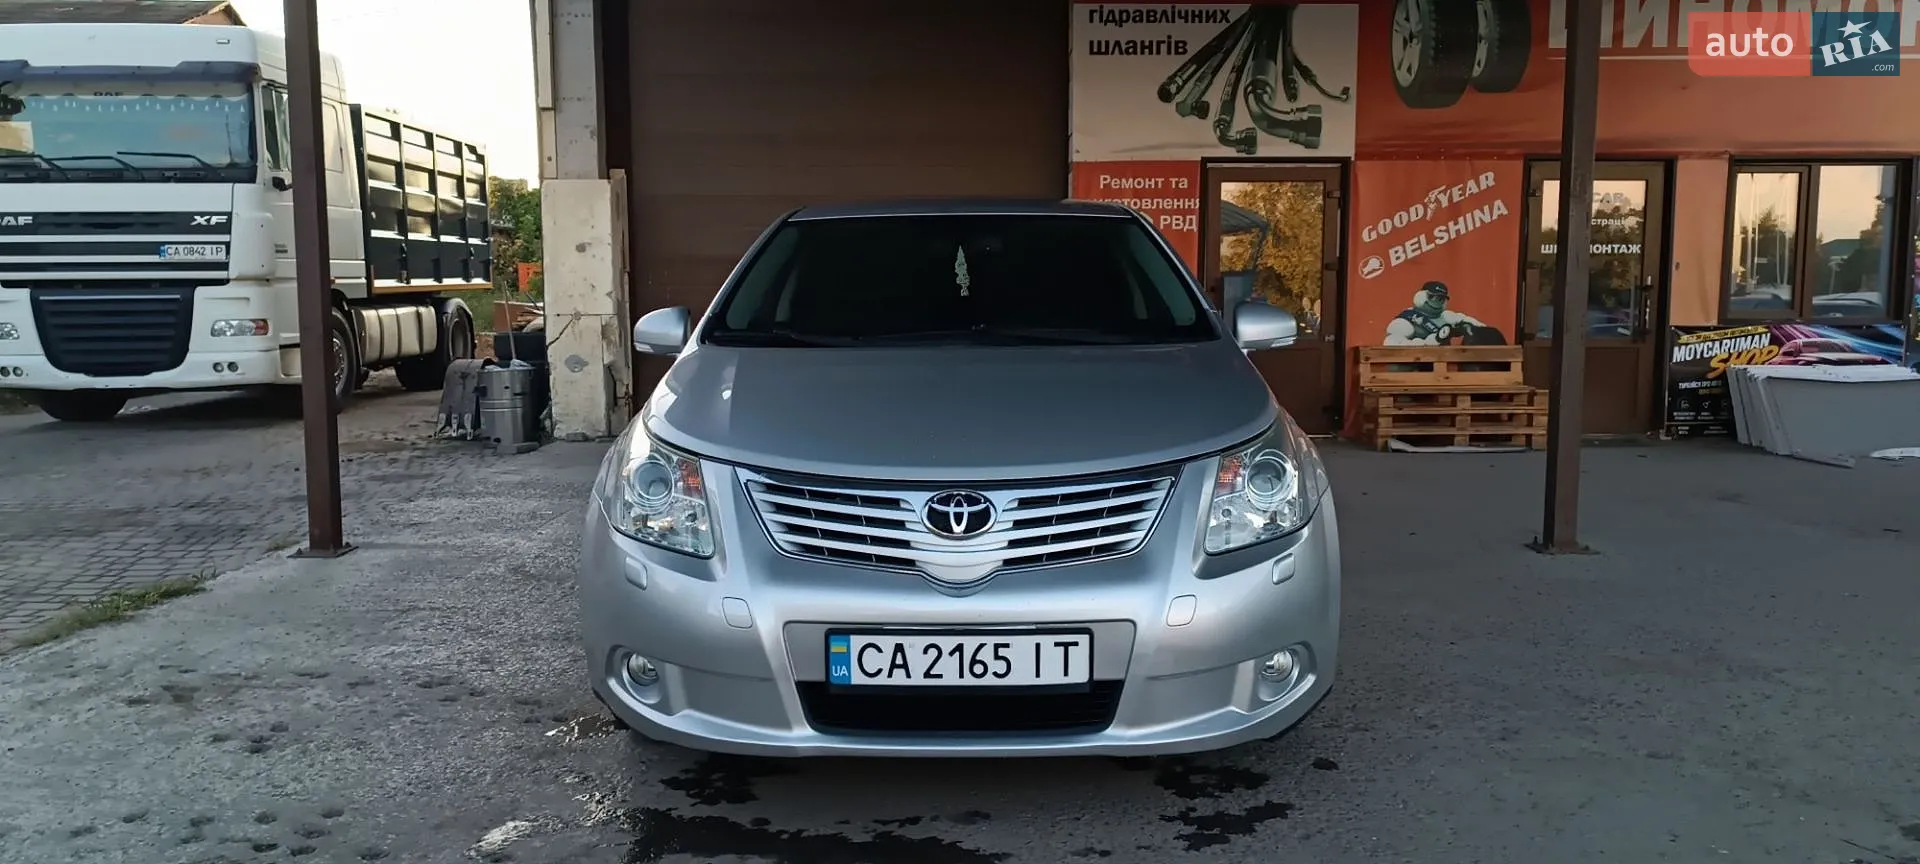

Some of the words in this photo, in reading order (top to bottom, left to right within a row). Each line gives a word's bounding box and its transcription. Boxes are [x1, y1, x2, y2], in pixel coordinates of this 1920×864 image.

[1089, 5, 1231, 27] гідравлічних
[1549, 0, 1920, 48] ИНОМО
[1089, 35, 1188, 56] шлангів
[1100, 175, 1165, 189] Ремонт
[1169, 177, 1188, 189] та
[0, 216, 33, 226] AF
[190, 215, 229, 226] XF
[1160, 215, 1197, 232] РВД
[1388, 199, 1509, 267] BELSHINA
[166, 246, 181, 257] CA
[183, 246, 206, 257] 0842
[210, 246, 223, 257] IP
[1672, 332, 1772, 363] MOYCARUMAN
[857, 643, 911, 678] CA
[923, 643, 1012, 678] 2165
[1035, 641, 1079, 678] IT
[832, 665, 848, 677] UA
